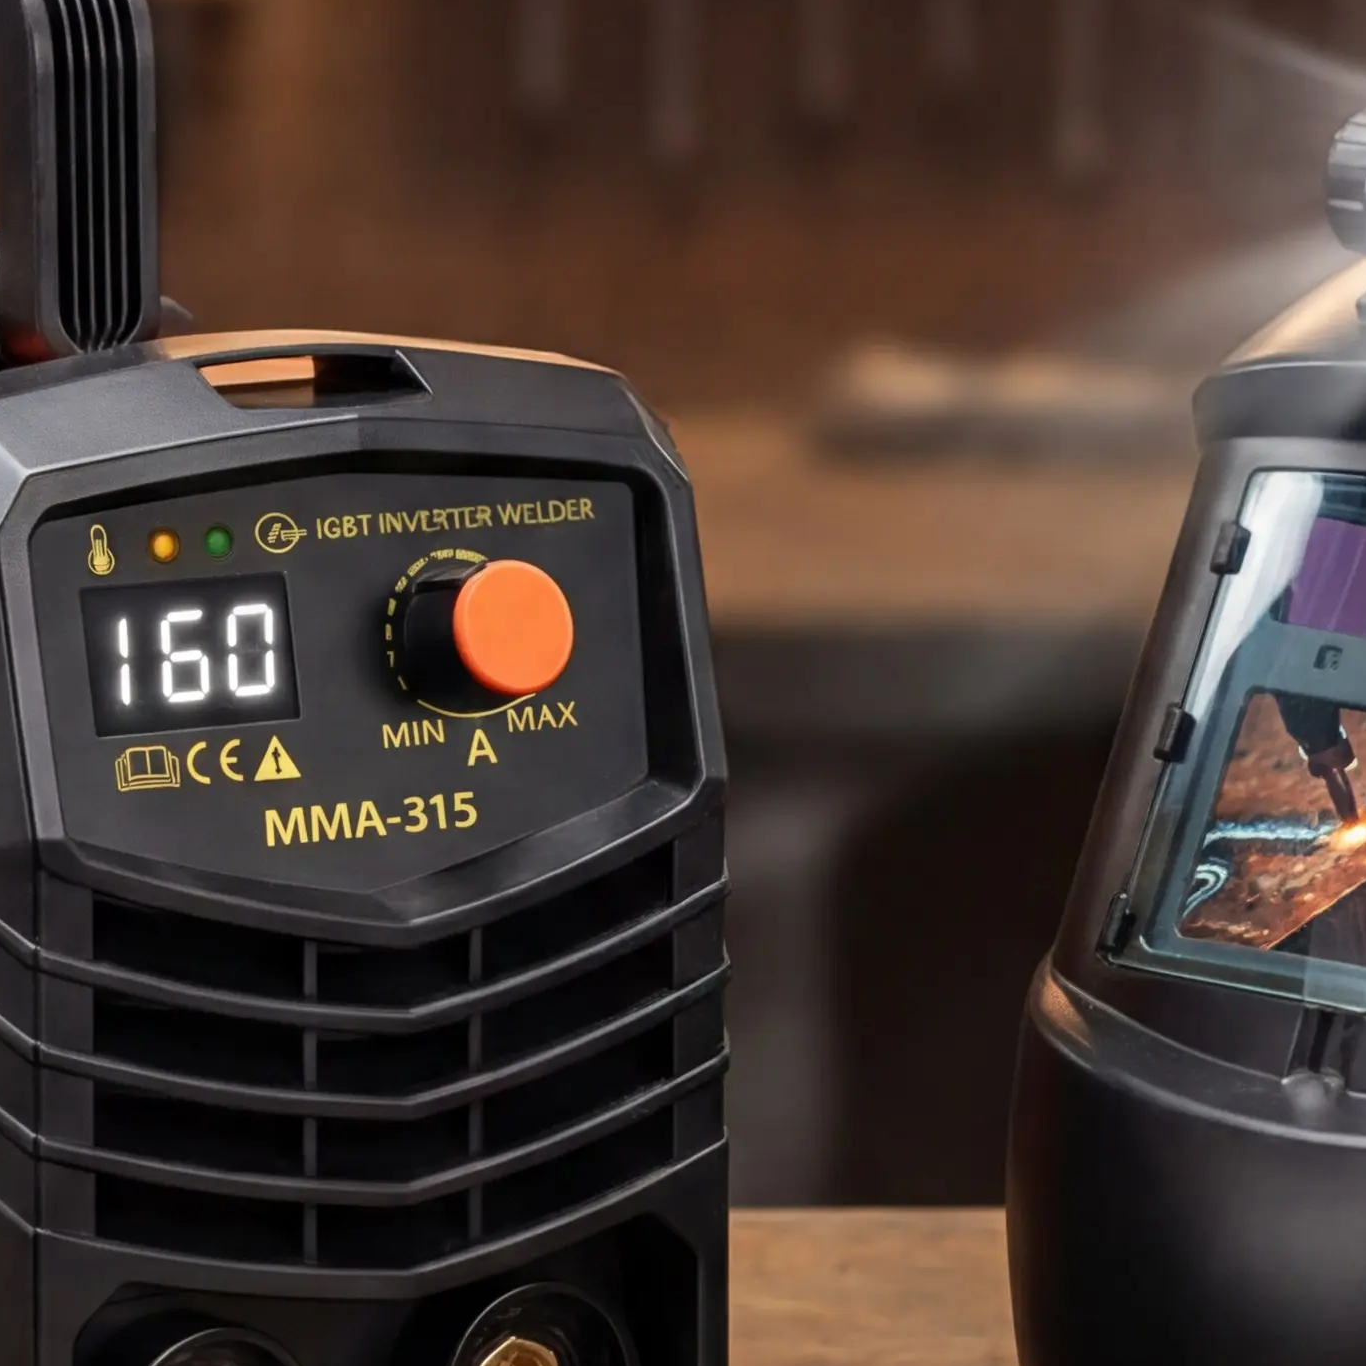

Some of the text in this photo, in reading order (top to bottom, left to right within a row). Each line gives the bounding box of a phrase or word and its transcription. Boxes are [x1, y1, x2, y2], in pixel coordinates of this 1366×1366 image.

[316, 497, 596, 540] IGBT INVERTER WELDER
[118, 603, 276, 707] 160
[382, 701, 579, 750] MIN MAX
[467, 729, 499, 767] A
[264, 791, 479, 848] MMA-315
